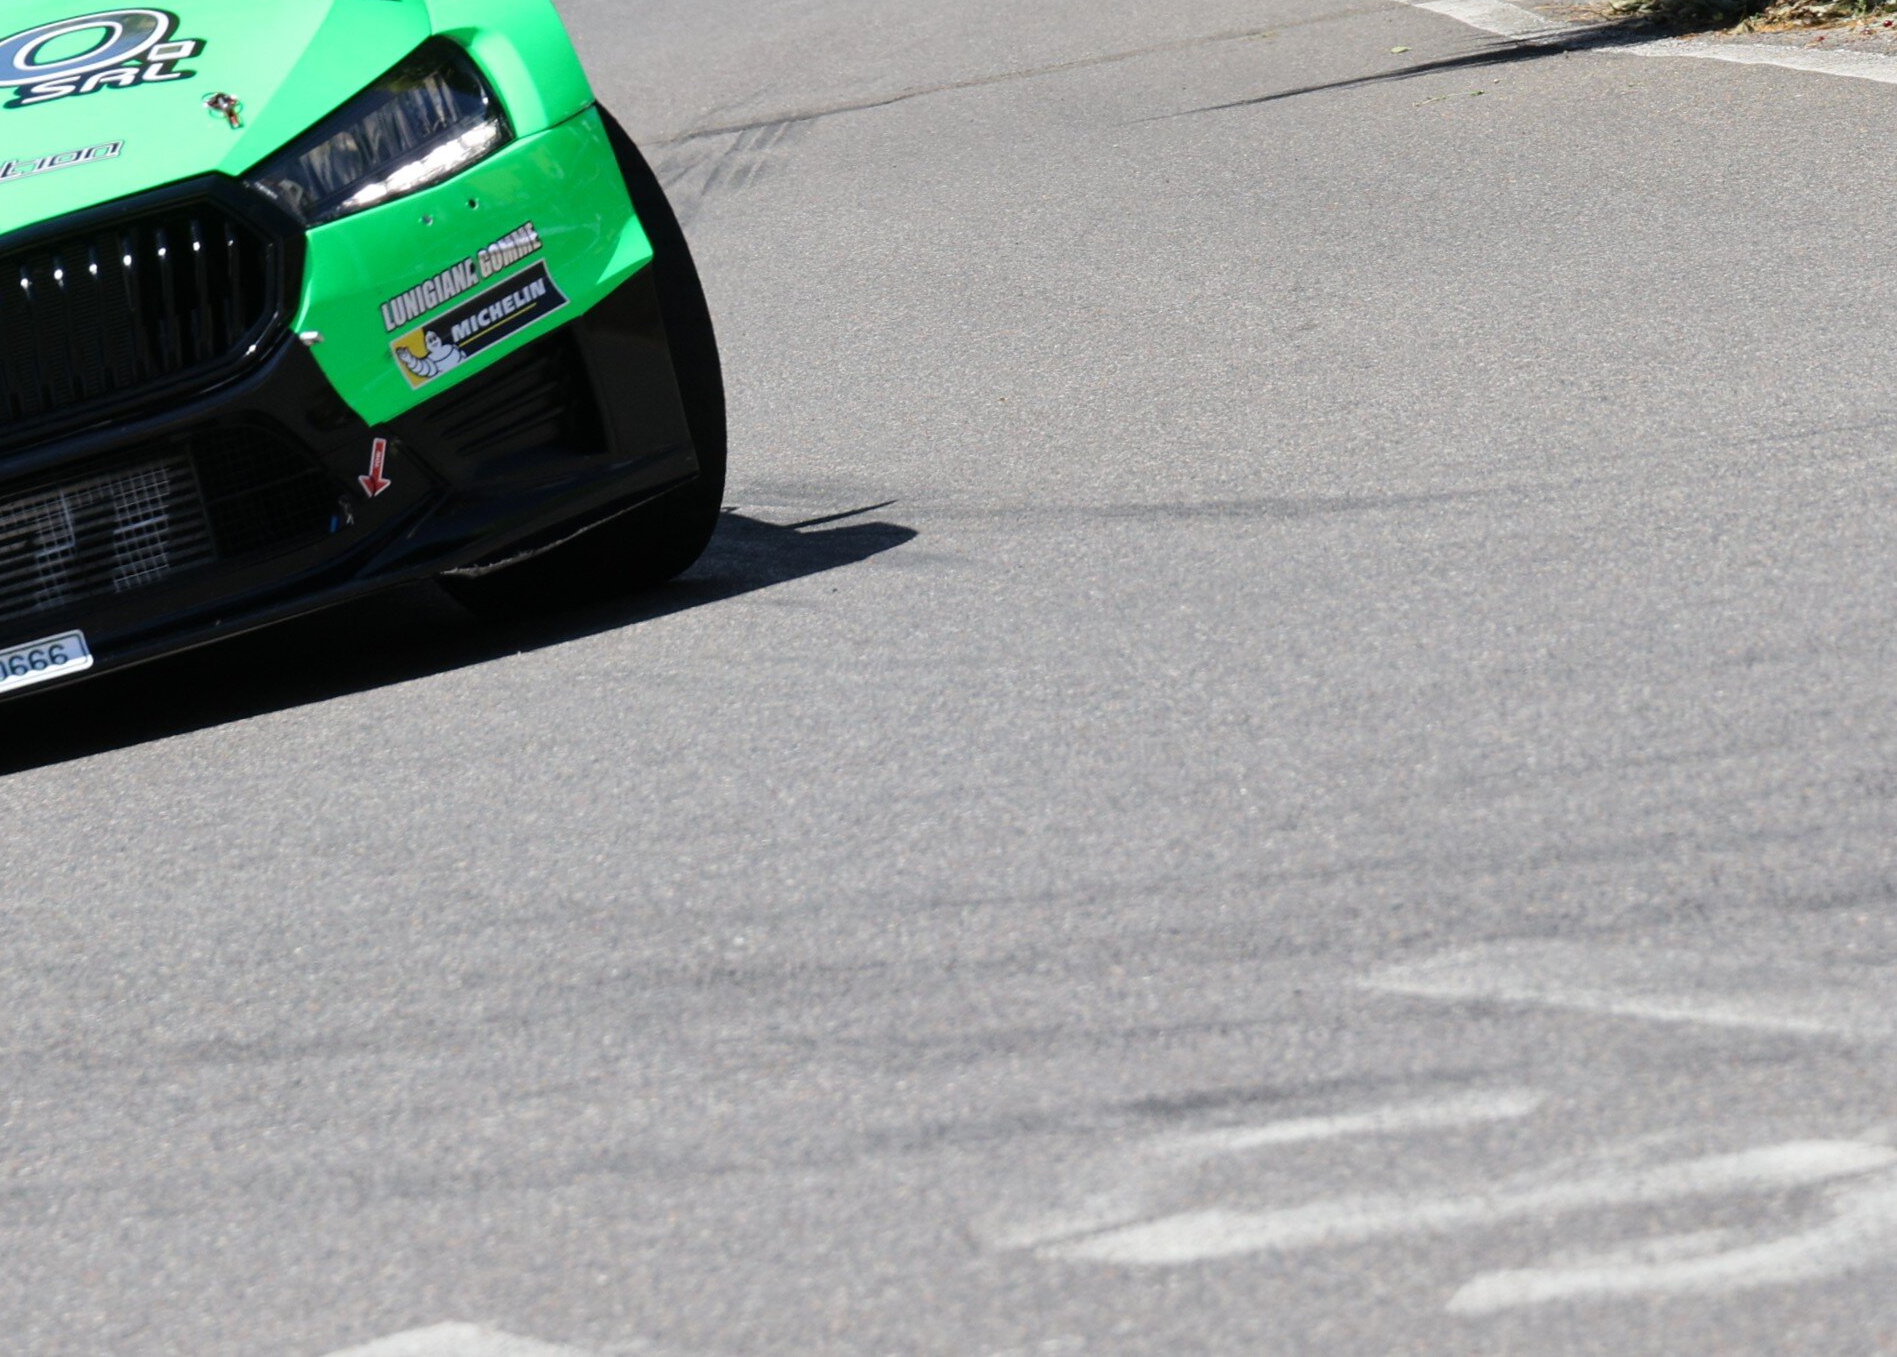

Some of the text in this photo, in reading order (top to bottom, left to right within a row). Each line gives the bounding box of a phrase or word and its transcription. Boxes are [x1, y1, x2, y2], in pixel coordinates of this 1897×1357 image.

[380, 221, 544, 334] LUNIGIANA GOMME
[449, 277, 548, 344] MICHELIN
